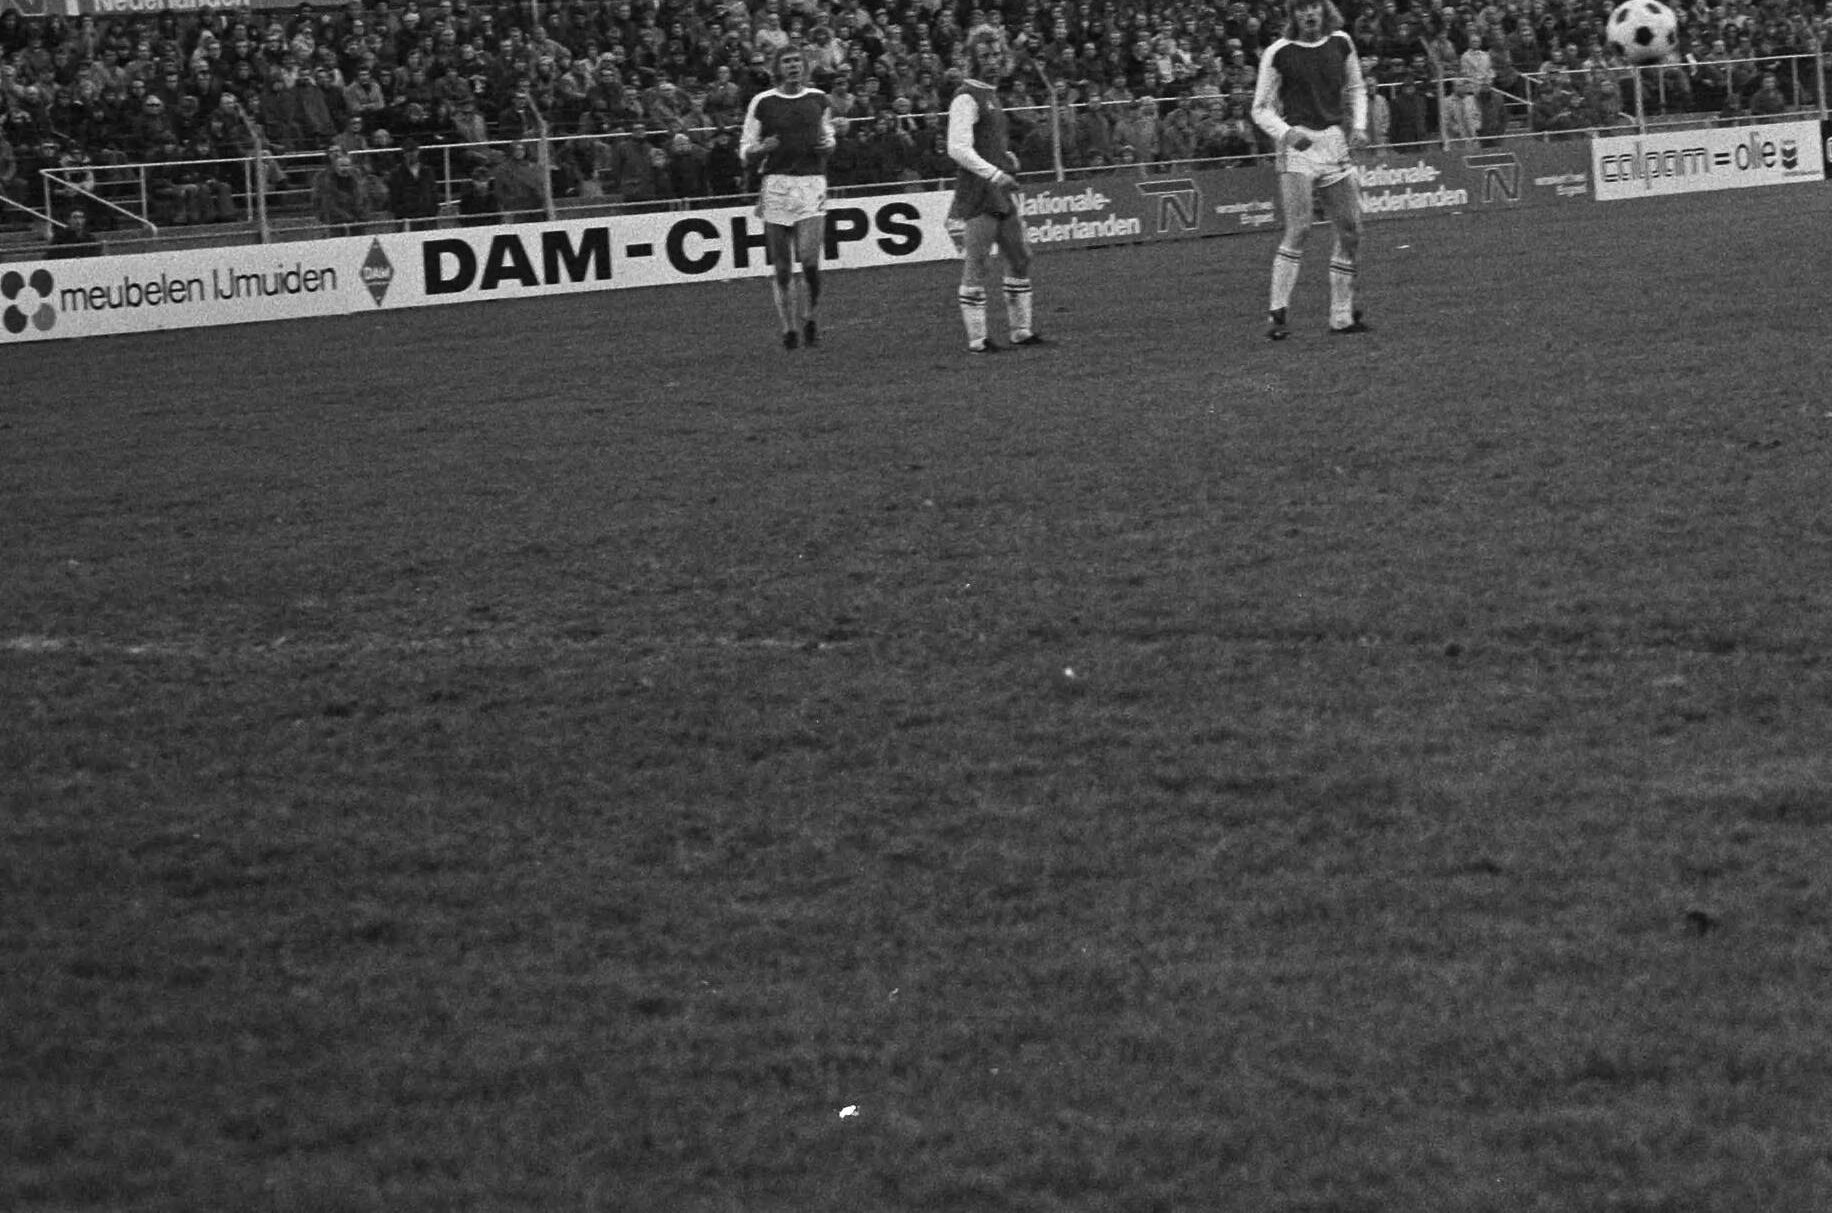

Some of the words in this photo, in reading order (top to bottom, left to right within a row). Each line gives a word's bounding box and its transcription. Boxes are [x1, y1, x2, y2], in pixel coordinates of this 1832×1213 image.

[422, 202, 922, 295] DAM-CHPS
[1021, 213, 1141, 243] ederlanden
[61, 274, 205, 311] meubelen
[213, 263, 337, 301] IJmuiden
